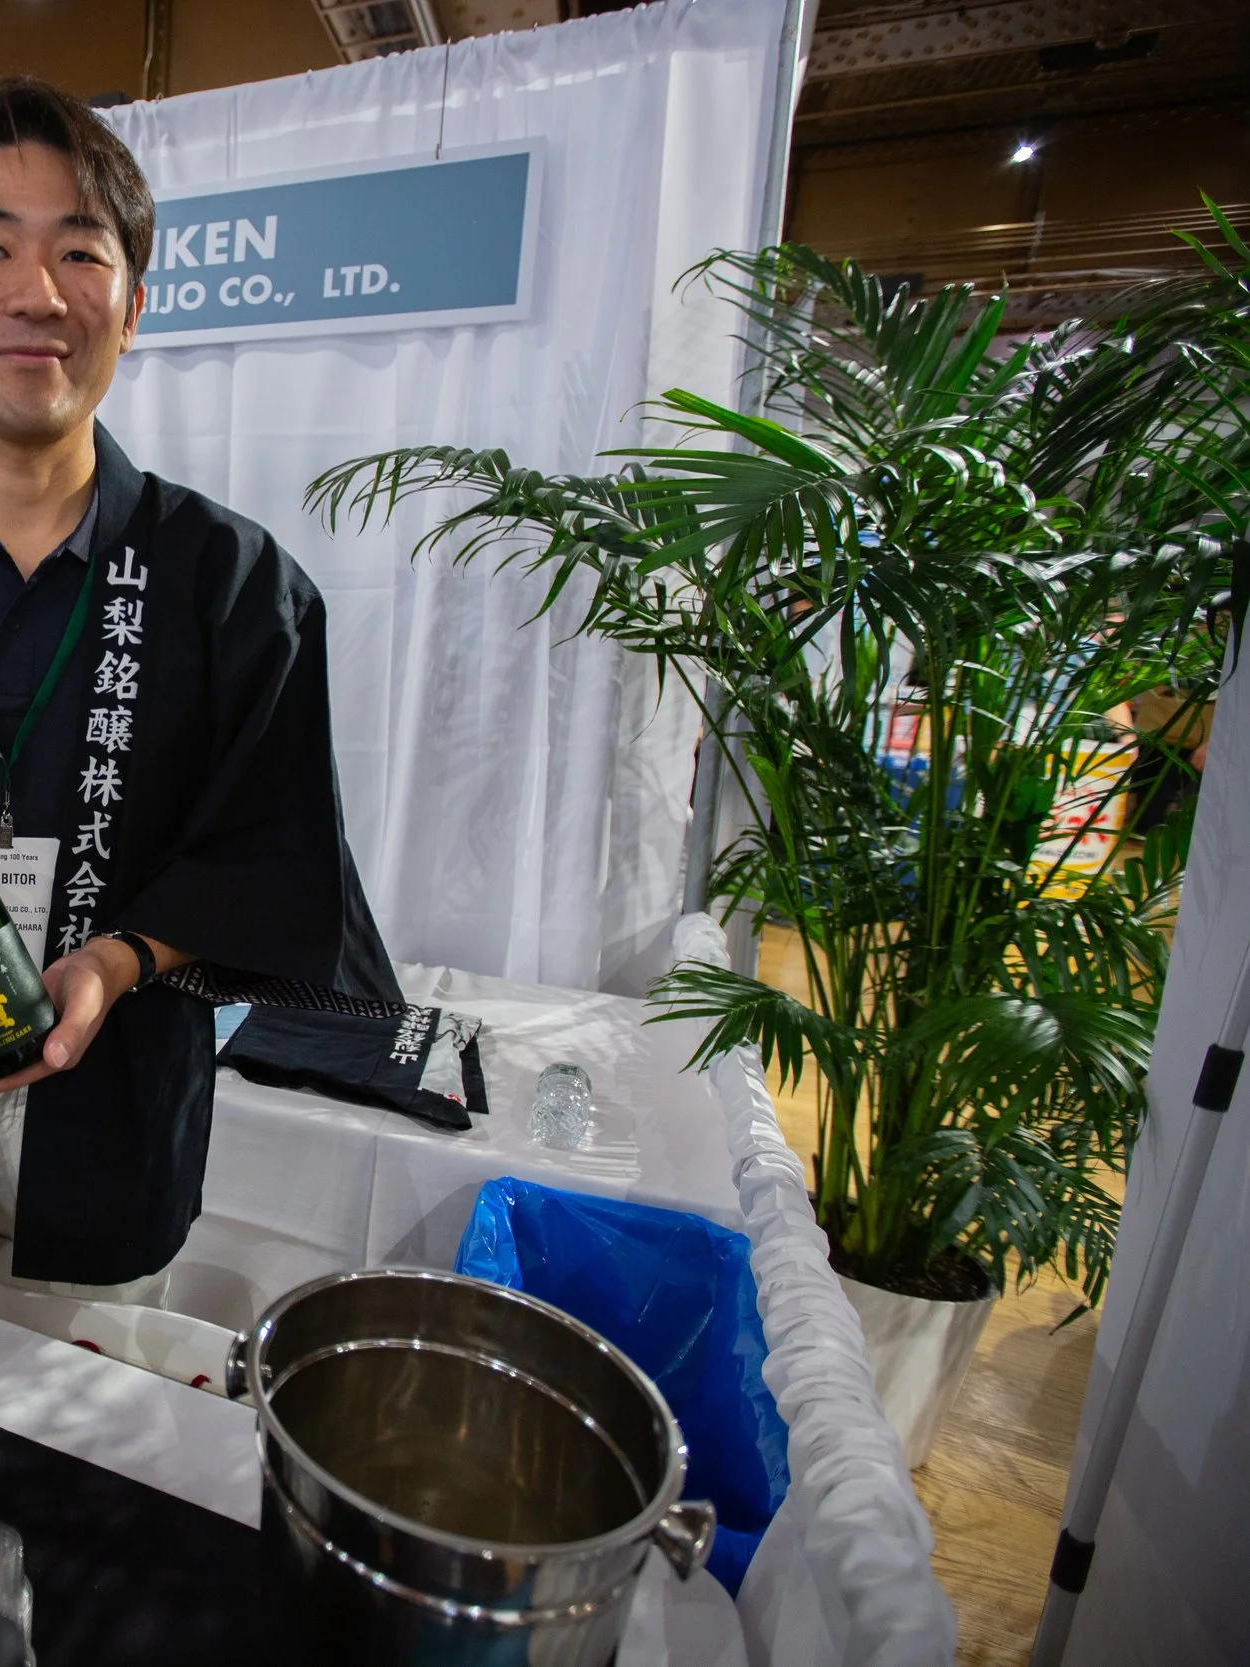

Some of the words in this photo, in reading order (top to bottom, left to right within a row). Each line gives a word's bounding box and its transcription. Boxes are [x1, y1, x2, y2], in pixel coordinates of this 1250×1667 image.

[147, 215, 278, 272] IKEN
[142, 281, 206, 315] IJO
[219, 274, 296, 307] CO.,
[322, 264, 401, 298] LTD.
